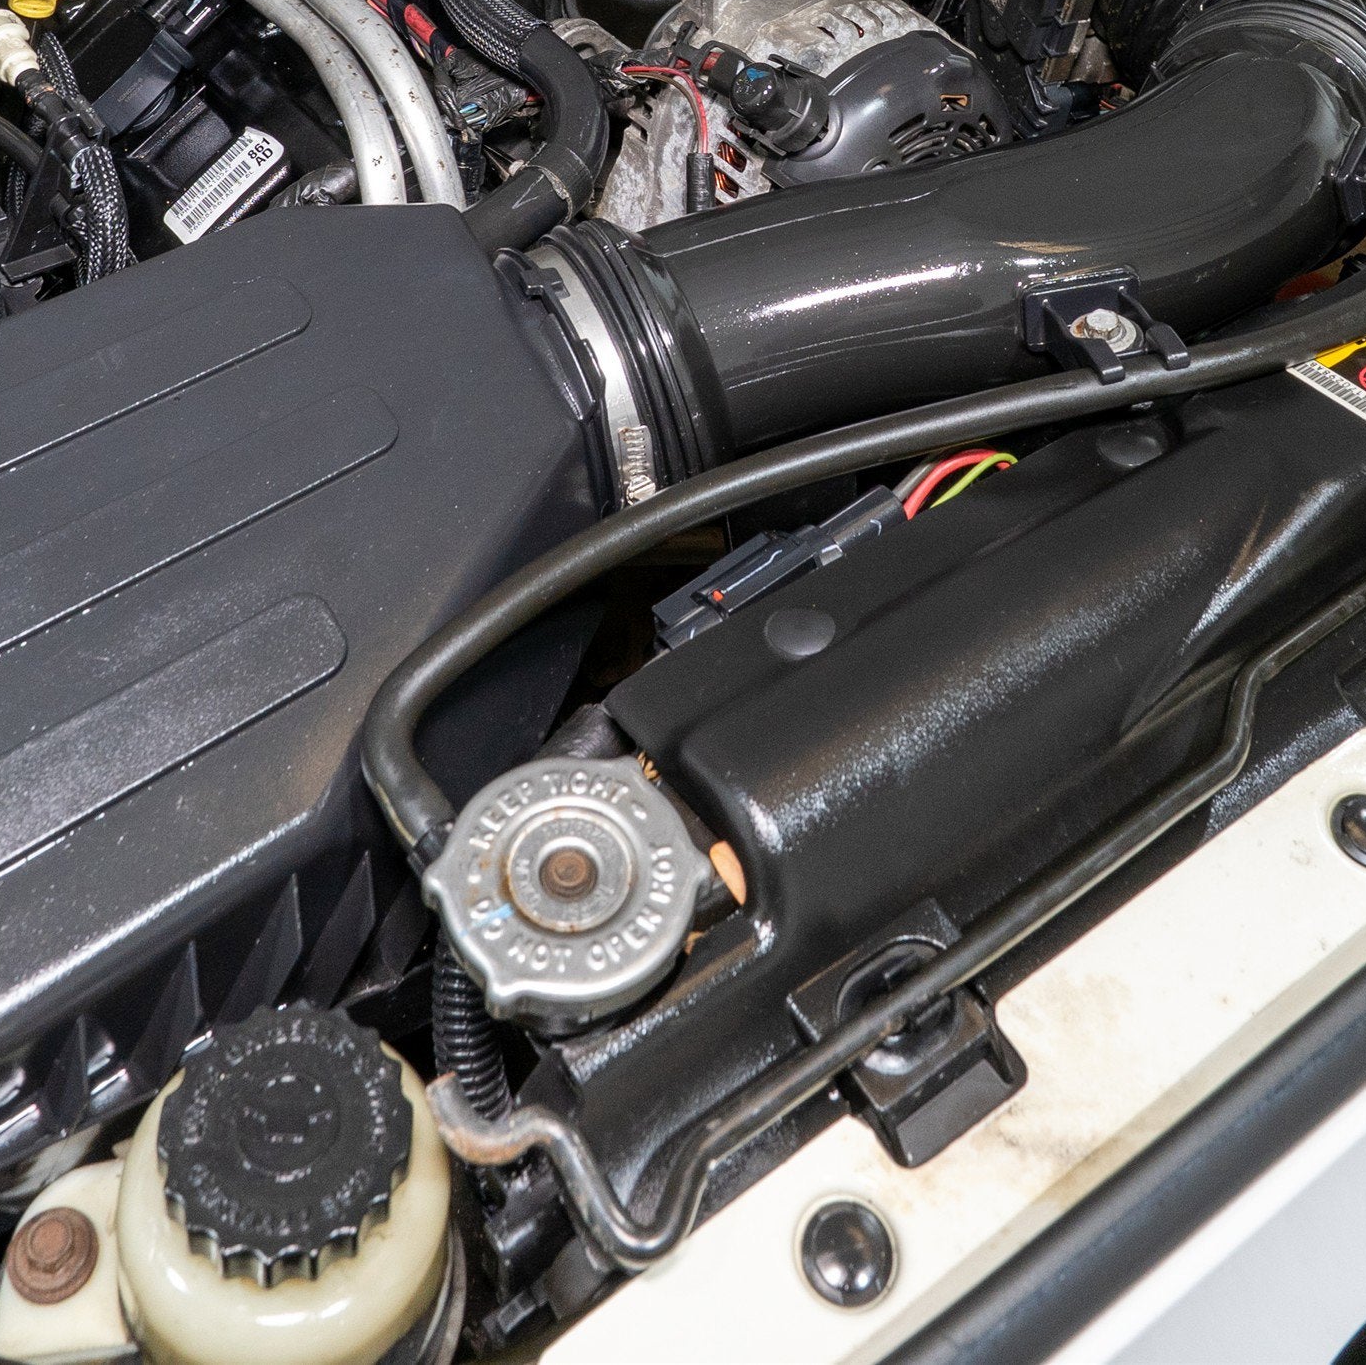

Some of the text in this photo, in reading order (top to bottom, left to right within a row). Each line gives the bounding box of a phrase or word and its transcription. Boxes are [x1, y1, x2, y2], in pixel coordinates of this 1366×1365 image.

[248, 137, 271, 160] 861
[255, 147, 274, 167] AD
[469, 772, 629, 850] KEEP TIGHT
[469, 899, 504, 940] DO
[507, 944, 573, 973] NOT
[587, 910, 663, 972] OPEN
[649, 846, 675, 904] HOT
